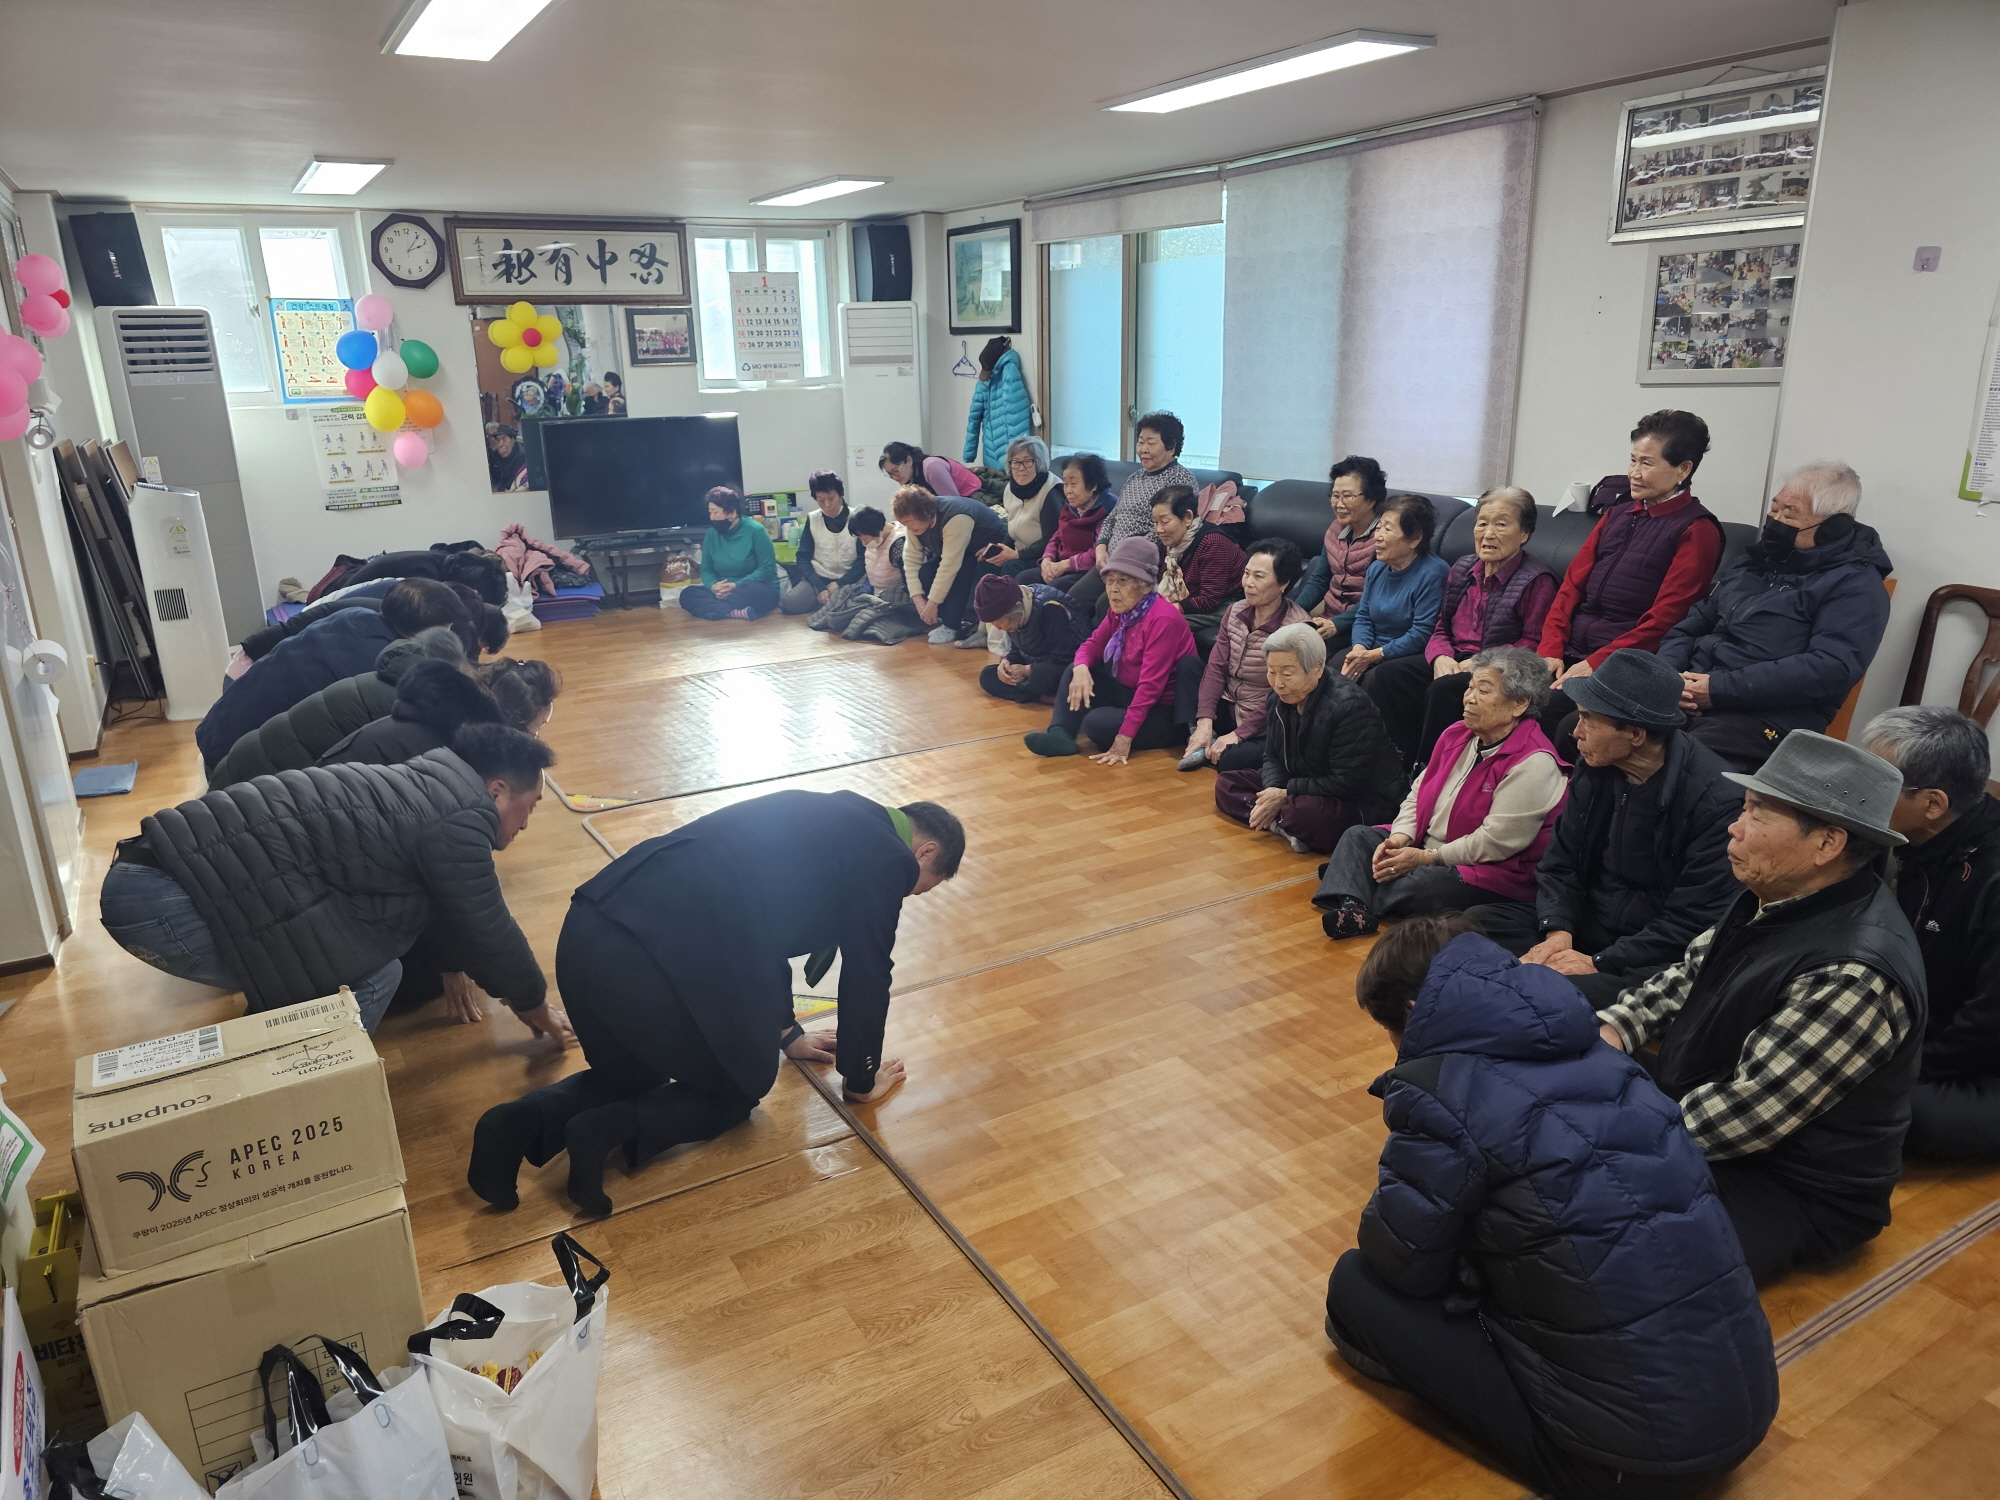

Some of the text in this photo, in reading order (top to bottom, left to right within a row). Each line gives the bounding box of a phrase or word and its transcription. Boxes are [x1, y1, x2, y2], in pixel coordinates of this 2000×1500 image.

[762, 276, 768, 287] 1
[298, 1055, 354, 1075] 1577-7011
[88, 1094, 212, 1134] coupang
[230, 1116, 344, 1164] APEC 2025
[232, 1150, 300, 1179] KOREA
[132, 1164, 354, 1239] 쿠팡이 2025년 APEC 정상회의의 성공적 개최를 응원합니다.
